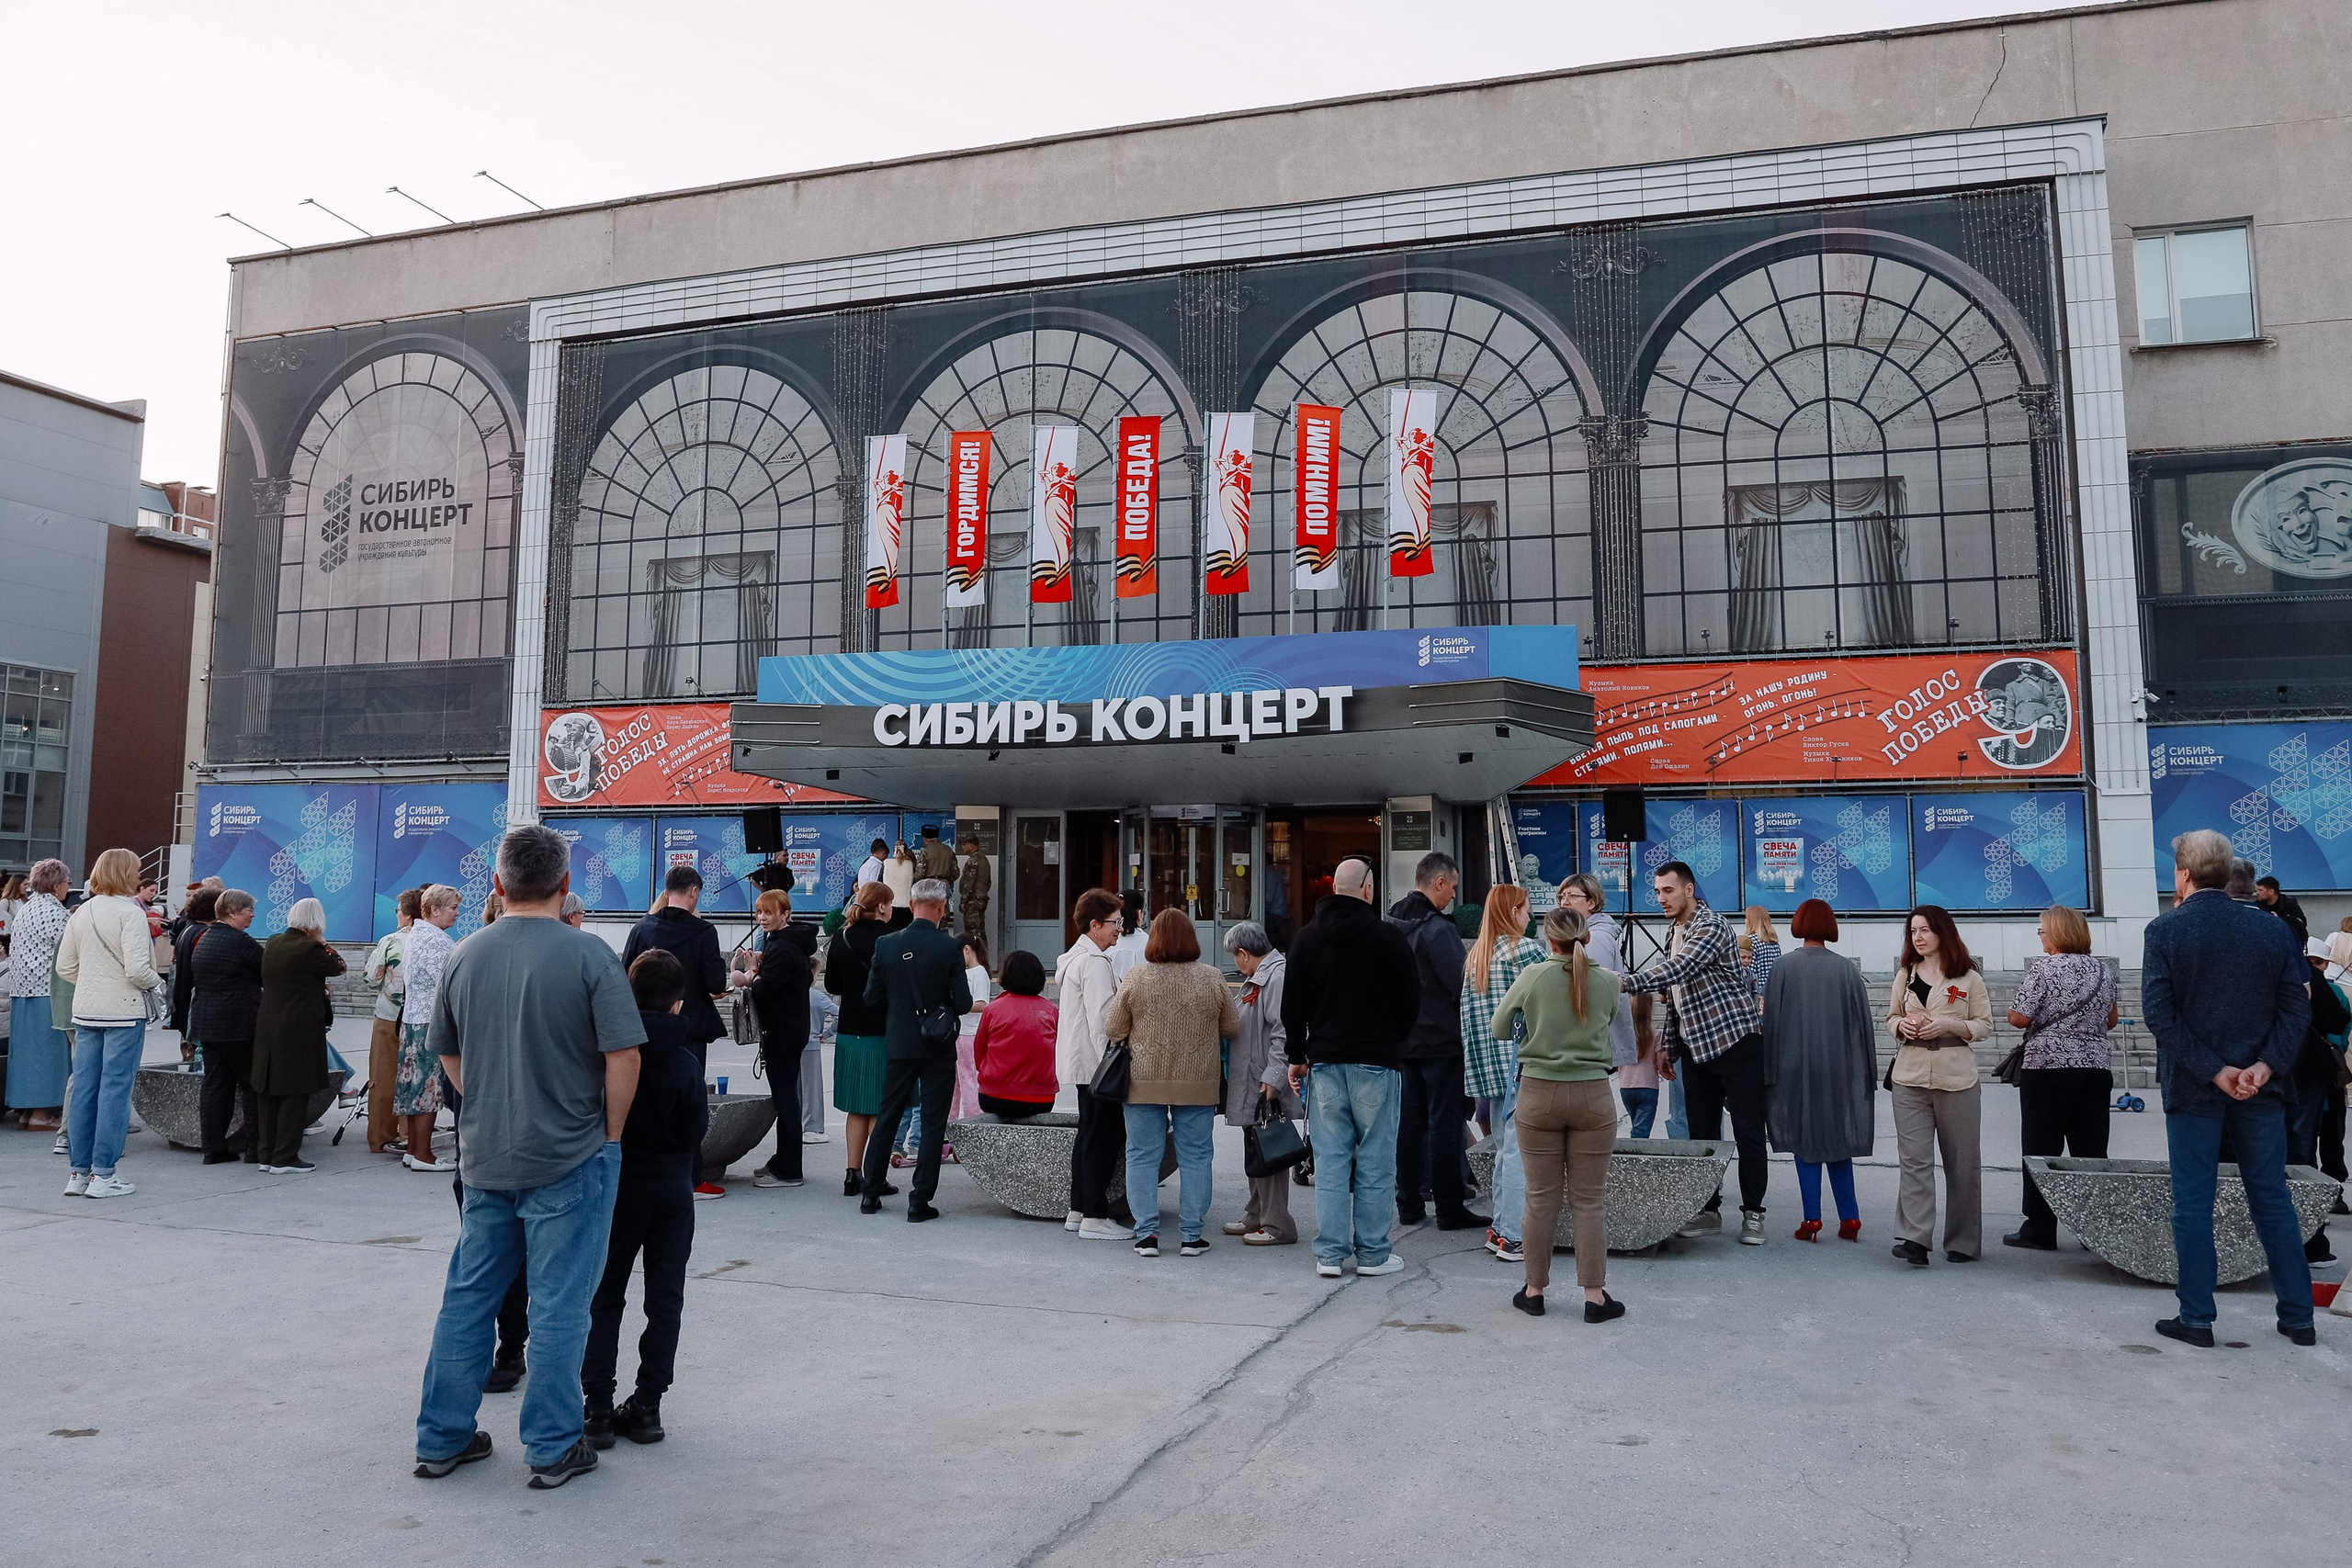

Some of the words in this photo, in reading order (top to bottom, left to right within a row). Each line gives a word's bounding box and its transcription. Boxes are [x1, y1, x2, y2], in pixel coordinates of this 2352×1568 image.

[1124, 434, 1152, 541] ПОБЕДА!
[1305, 417, 1330, 536] ПОМНИМ!
[360, 478, 455, 505] СИБИРЬ
[956, 440, 981, 558] ГОРДИМСЯ!
[359, 503, 473, 533] КОНЦЕРТ
[357, 538, 412, 551] государственное
[413, 536, 452, 547] автономное
[397, 547, 426, 558] культуры
[1433, 637, 1468, 646] СИБИРЬ
[1433, 646, 1476, 655] КОНЦЕРТ
[1738, 693, 1753, 706] ЗА
[1755, 680, 1783, 698] НАШУ
[1786, 671, 1828, 687] РОДИНУ
[1781, 687, 1817, 704] ОГОНЬ!
[1876, 669, 1961, 733] ГОЛОС
[873, 700, 1079, 747] СИБИРЬ
[1091, 685, 1353, 743] КОНЦЕРТ
[1881, 690, 1990, 766] ПОБЕДЫ
[594, 713, 652, 766] ГОЛОС
[1606, 730, 1634, 747] ПЫЛЬ
[1637, 725, 1659, 737] ПОД
[1664, 713, 1718, 731] САПОГАМИ
[595, 730, 670, 792] ПОБЕДЫ
[662, 766, 671, 776] НЕ
[671, 749, 698, 770] СТРАШНА
[698, 740, 713, 751] НАМ
[2169, 746, 2214, 755] СИБИРЬ
[2170, 756, 2223, 766] КОНЦЕРТ
[1574, 751, 1621, 778] СТЕЯМИ,
[222, 815, 262, 826] КОНЦЕРТ
[223, 806, 256, 815] СИБИРЬ
[408, 816, 450, 826] КОНЦЕРТ
[409, 806, 445, 815] СИБИРЬ
